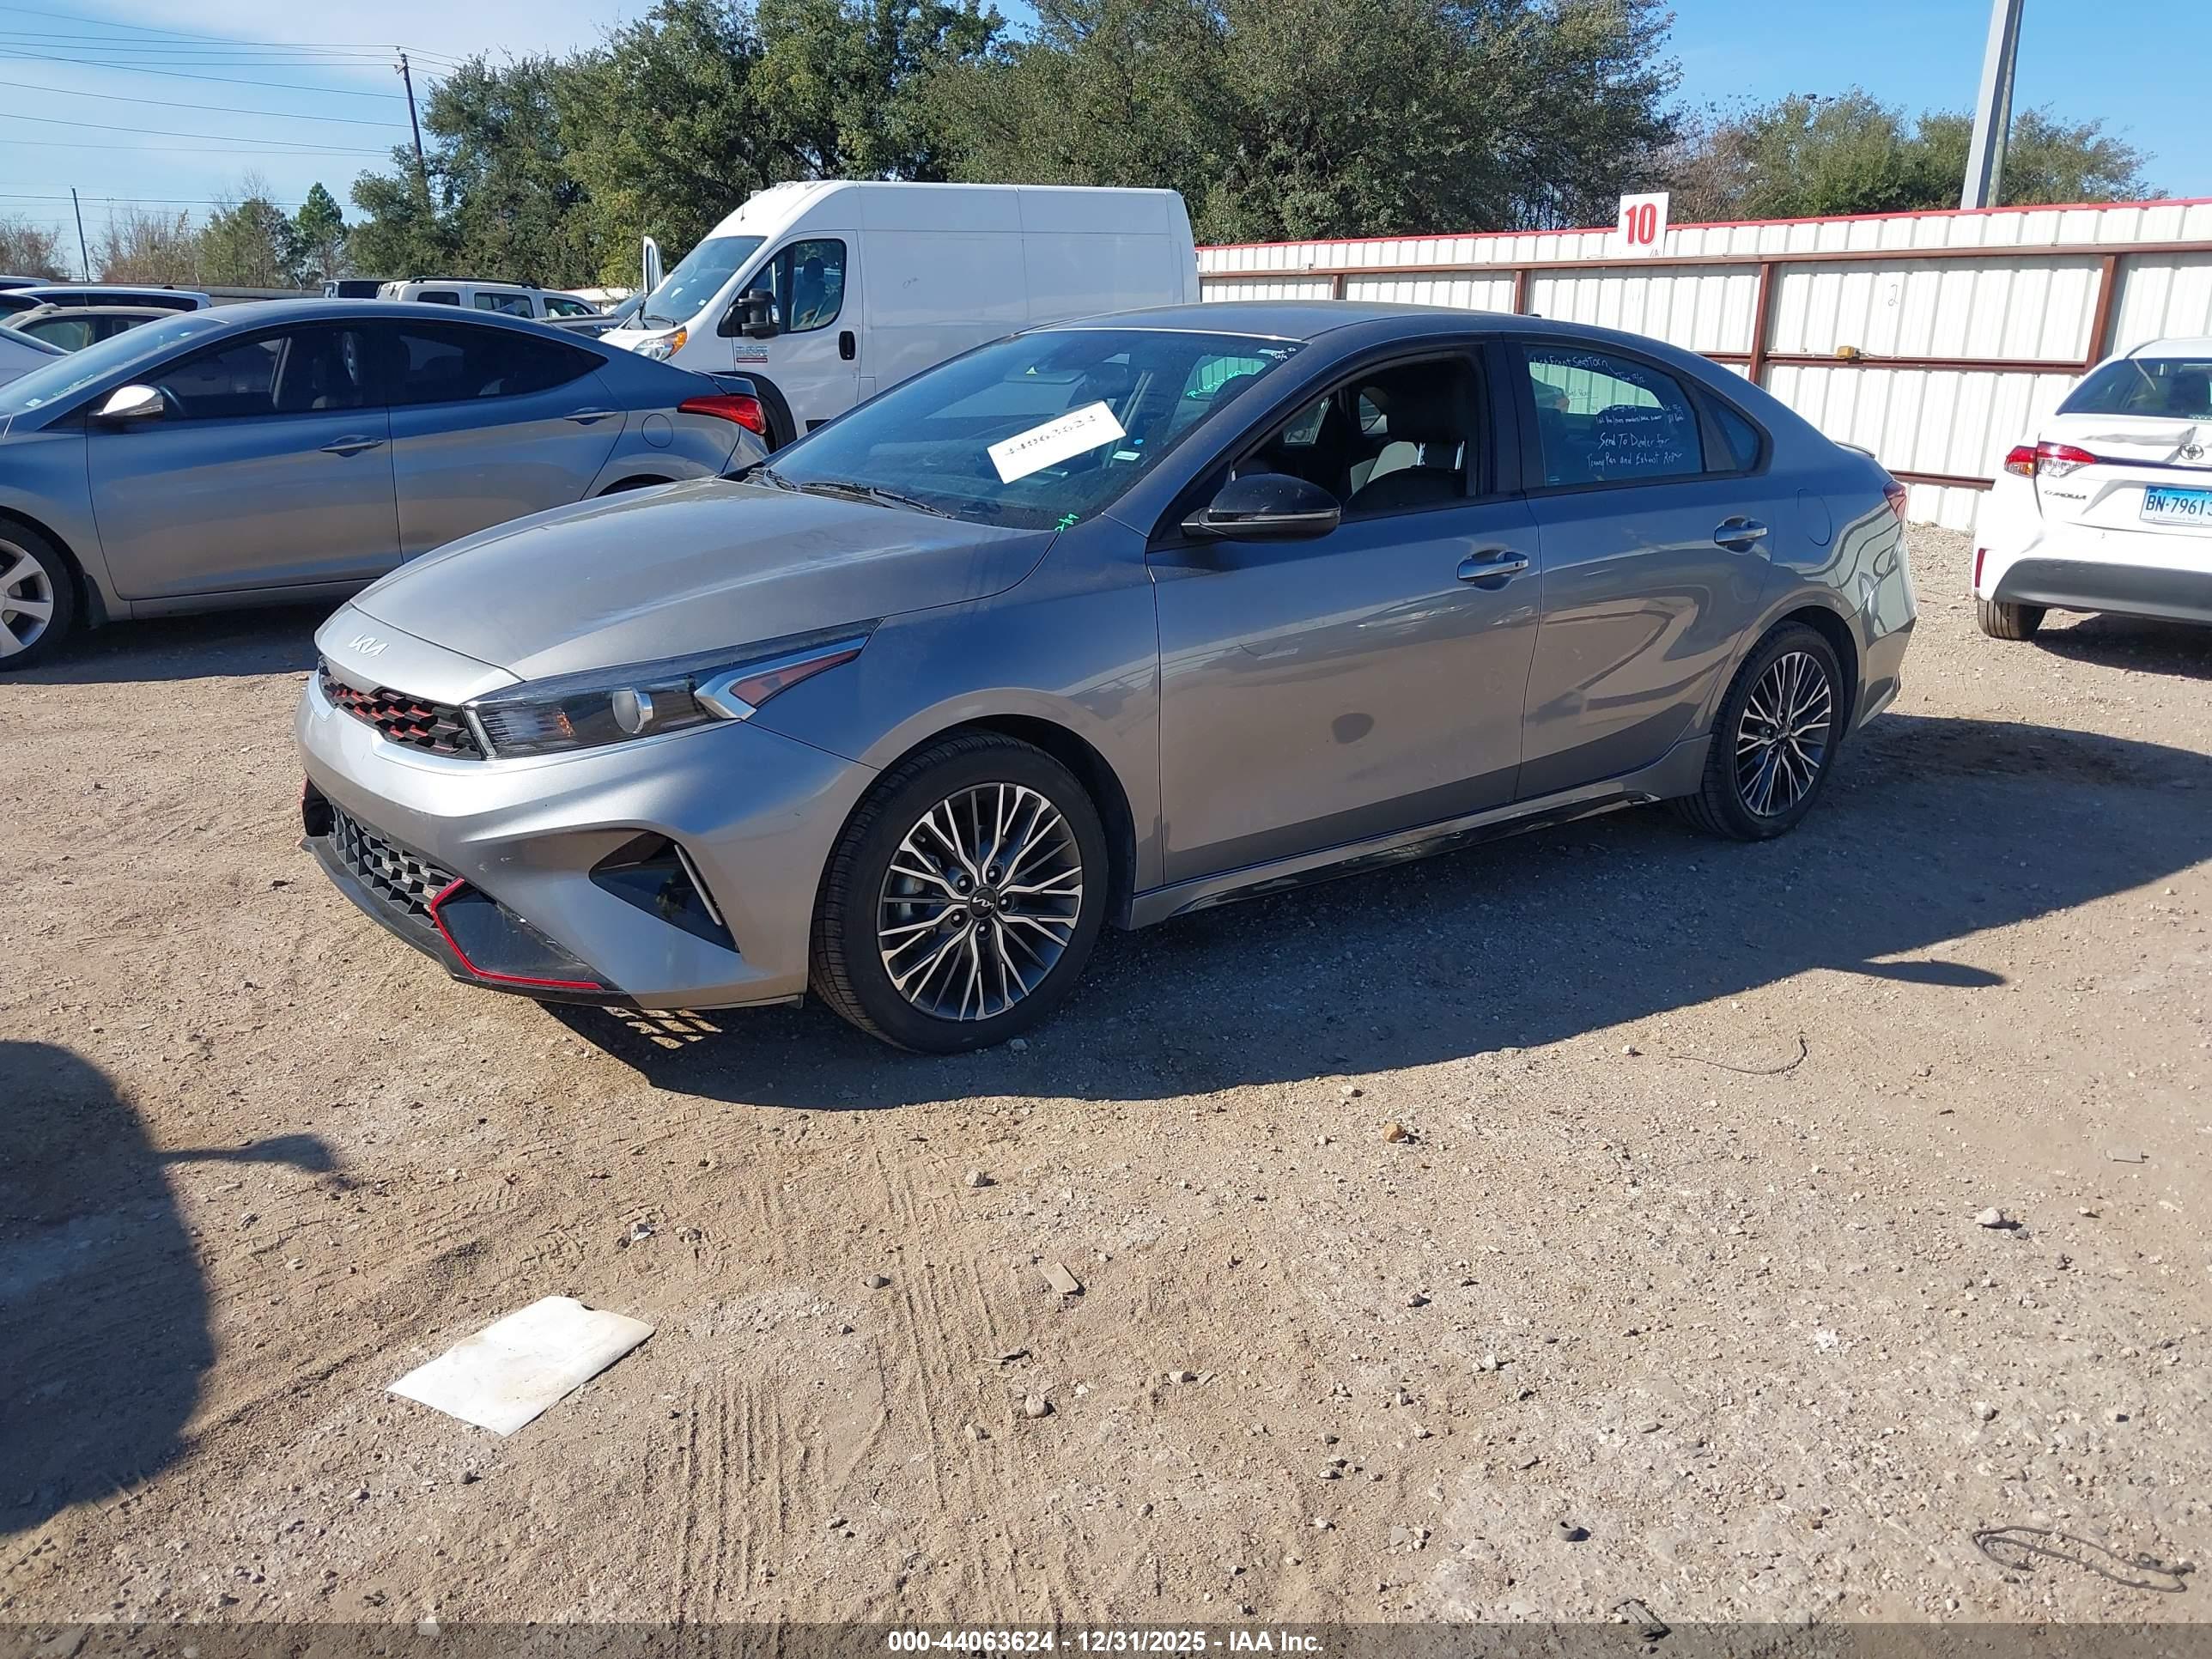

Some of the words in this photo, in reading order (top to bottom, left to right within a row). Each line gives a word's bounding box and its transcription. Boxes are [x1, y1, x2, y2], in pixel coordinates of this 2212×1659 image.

[1625, 203, 1656, 246] 10
[1598, 432, 1616, 449] Send
[1618, 433, 1628, 449] To
